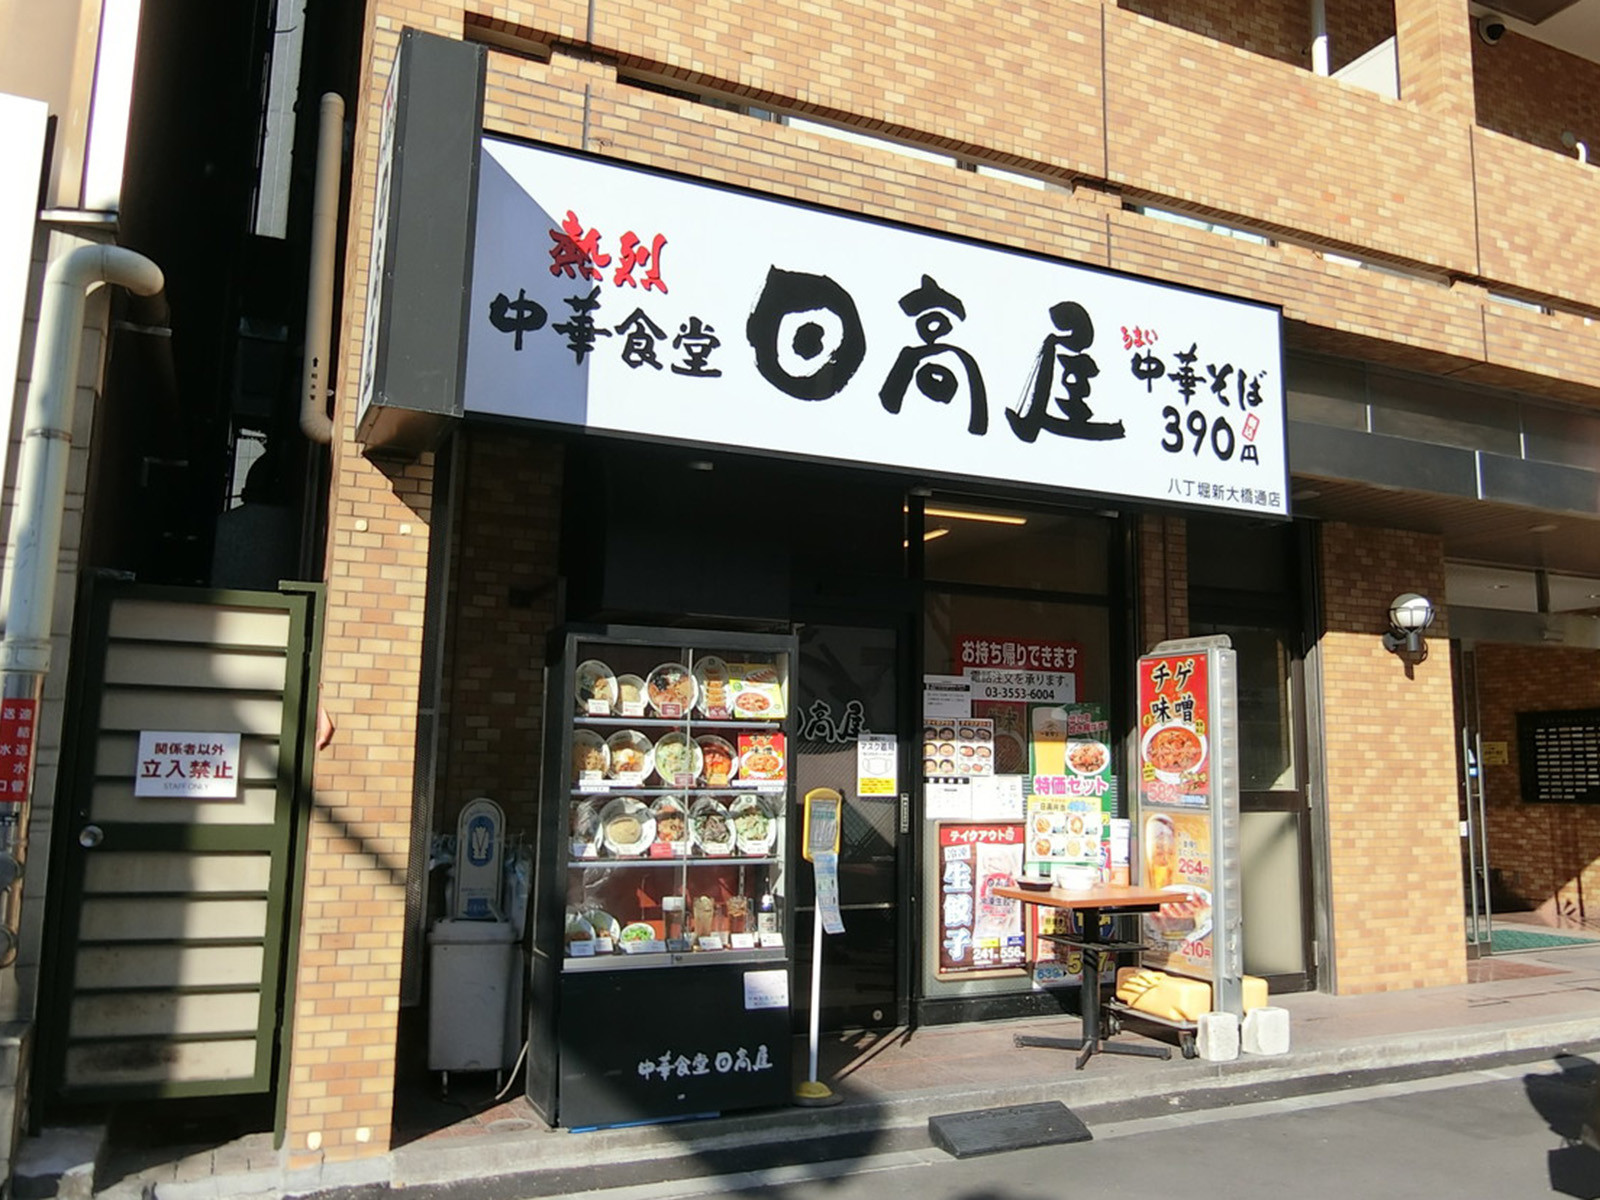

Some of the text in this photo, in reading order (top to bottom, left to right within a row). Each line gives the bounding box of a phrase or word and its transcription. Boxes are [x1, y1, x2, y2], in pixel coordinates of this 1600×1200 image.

[549, 210, 668, 294] 熱烈
[489, 286, 722, 377] 中華食堂
[1121, 325, 1158, 350] うまい
[746, 264, 1126, 443] 日高屋
[1130, 343, 1267, 410] 中華そば
[1167, 478, 1281, 507] 八丁堀新大橋通店
[962, 641, 1077, 668] お持ち帰りできます
[1151, 660, 1194, 692] チゲ
[985, 686, 1054, 700] 03-3553-6004
[797, 700, 871, 744] 高屋
[1151, 695, 1194, 723] 味噌
[155, 742, 225, 755] 関係者以外
[140, 759, 234, 779] 立入禁止
[164, 782, 185, 790] STAFF
[1034, 776, 1109, 795] 特価セット
[950, 829, 1005, 842] テイクアウト
[638, 1044, 773, 1080] 中華食堂 日高屋
